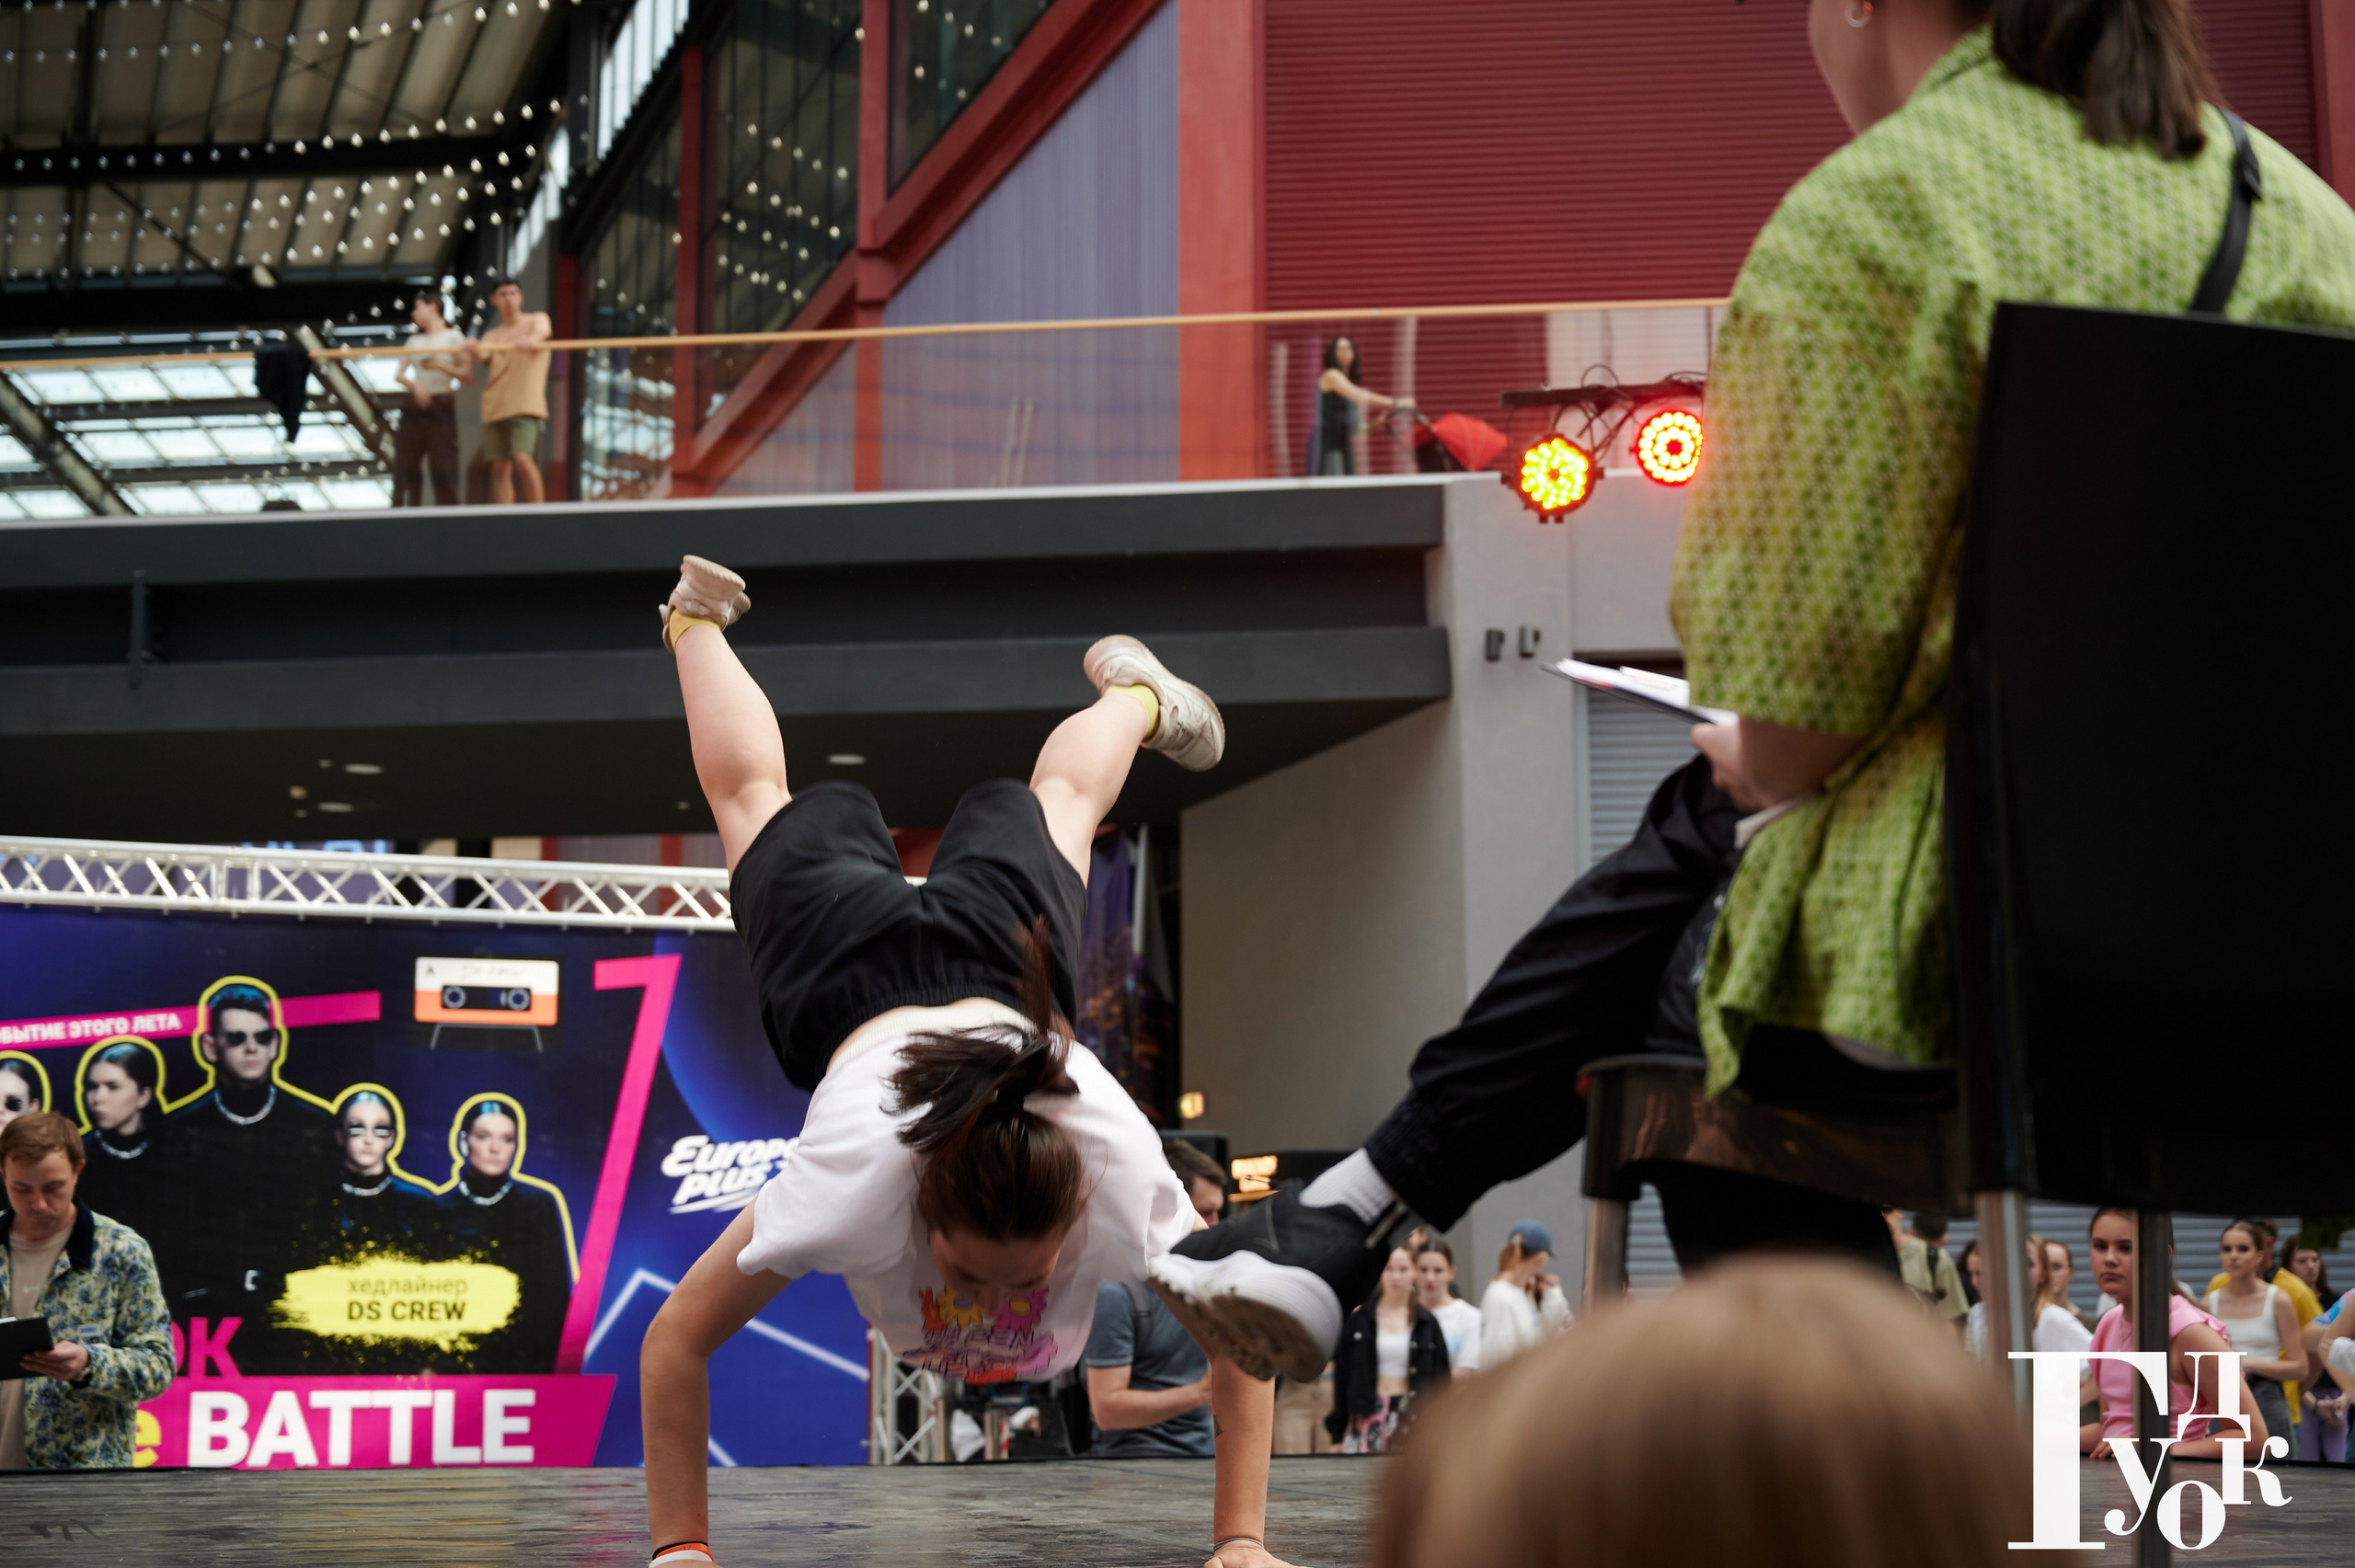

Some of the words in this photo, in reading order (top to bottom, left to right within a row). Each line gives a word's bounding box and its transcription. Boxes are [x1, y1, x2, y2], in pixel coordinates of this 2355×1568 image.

[0, 1023, 65, 1045] БЫТИЕ
[68, 1017, 130, 1039] ЭТОГО
[132, 1013, 182, 1033] ЛЕТА
[348, 1276, 468, 1299] хедлайнер
[348, 1300, 382, 1321] DS
[391, 1300, 466, 1321] CREW
[188, 1389, 535, 1468] BATTLE
